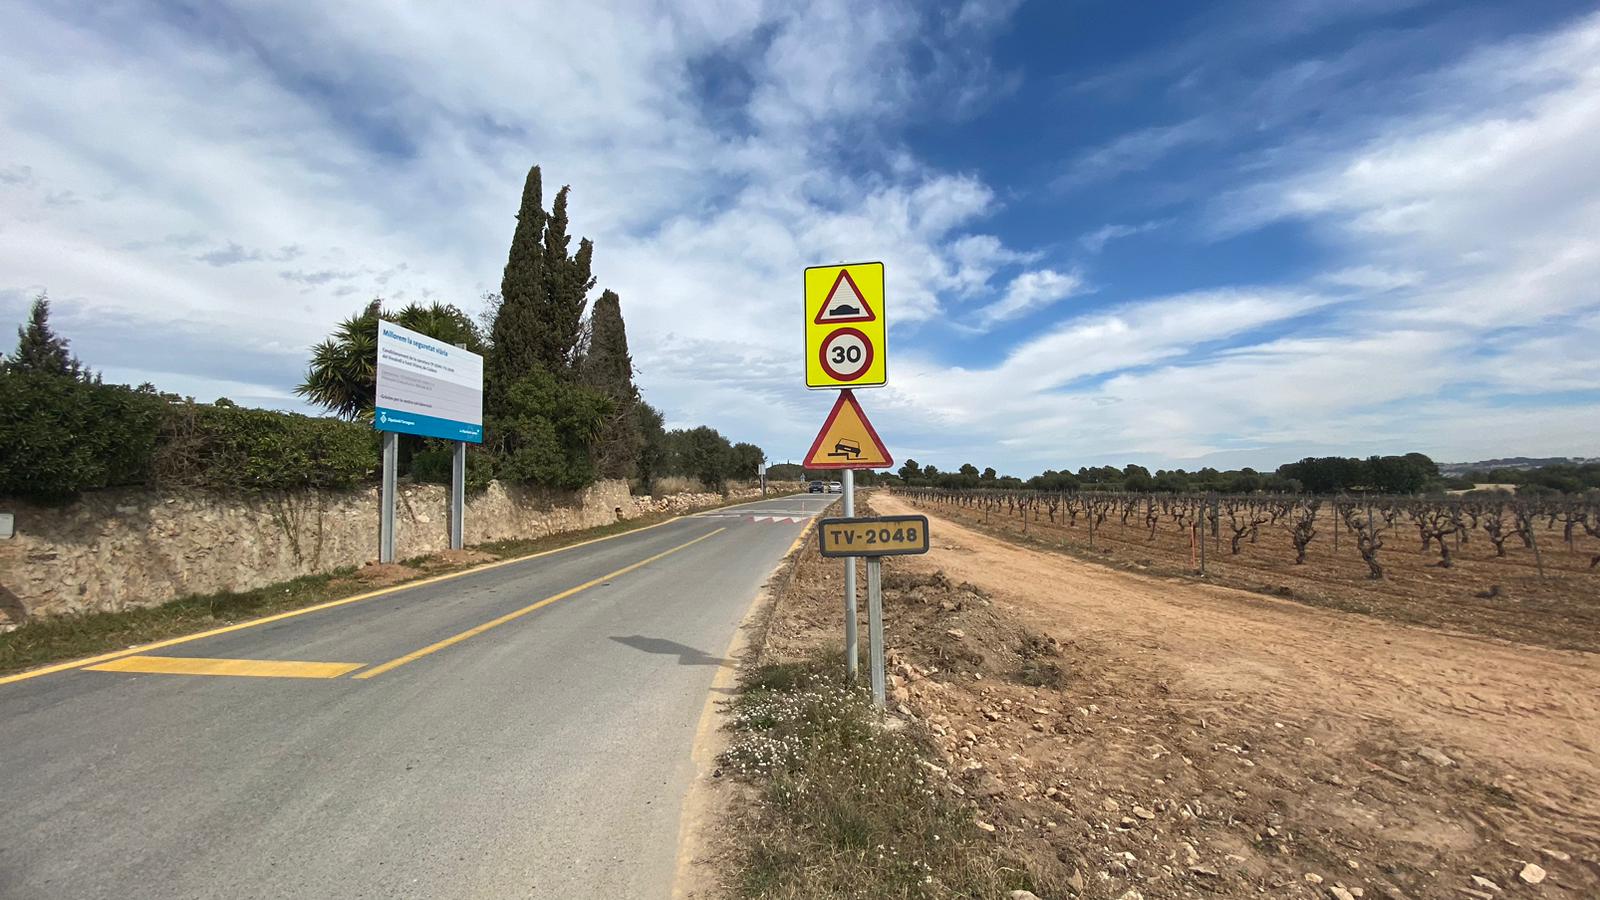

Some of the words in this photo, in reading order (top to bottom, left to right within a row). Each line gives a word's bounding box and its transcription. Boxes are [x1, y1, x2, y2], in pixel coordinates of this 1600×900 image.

[412, 340, 435, 353] seguretat
[832, 345, 861, 364] 30
[831, 528, 917, 544] TV-2048
